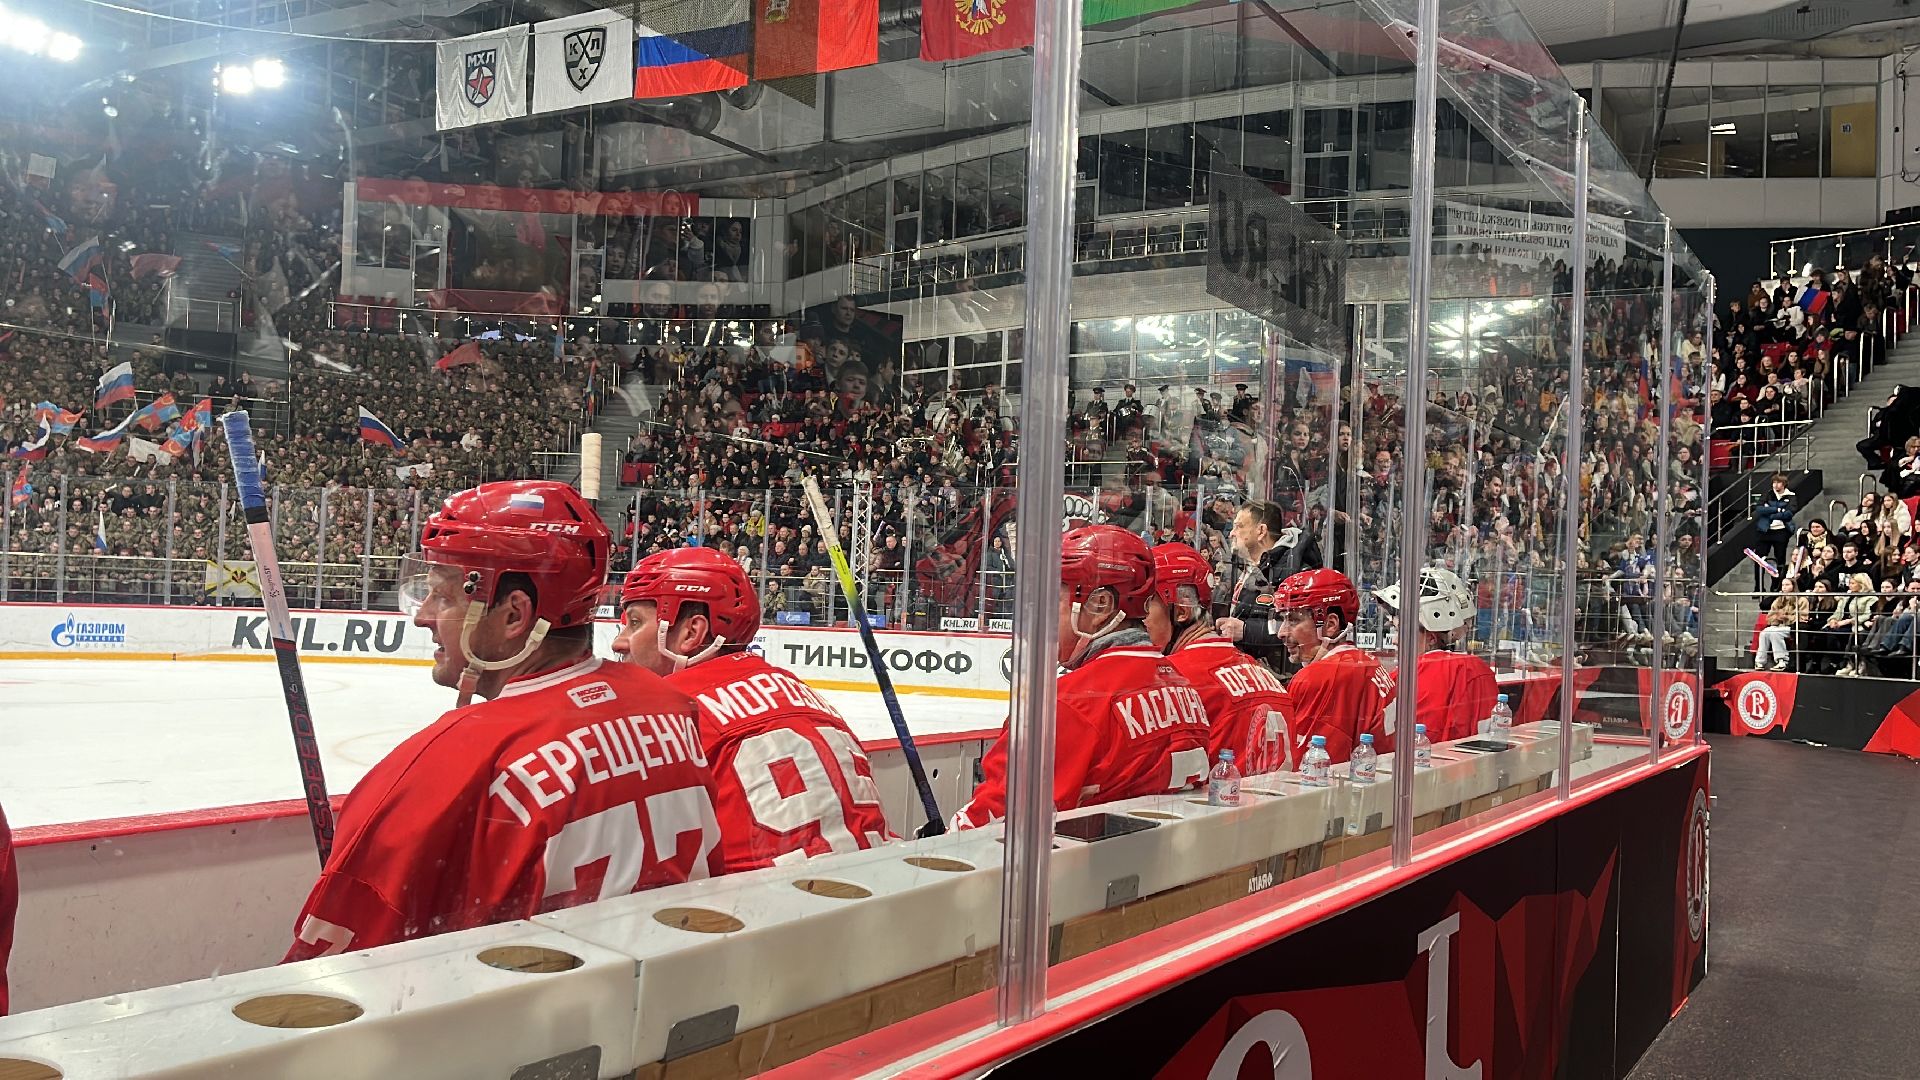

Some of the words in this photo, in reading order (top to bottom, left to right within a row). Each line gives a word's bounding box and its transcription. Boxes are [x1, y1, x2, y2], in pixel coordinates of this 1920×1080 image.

[467, 51, 495, 67] МХЛ
[529, 522, 580, 534] CCM
[675, 584, 711, 593] CCM
[76, 623, 125, 634] ГАЗПРОМ
[943, 619, 976, 628] KHL.RU
[697, 672, 844, 726] МОРОЗО
[489, 713, 708, 828] ТЕРЕЩЕНКО
